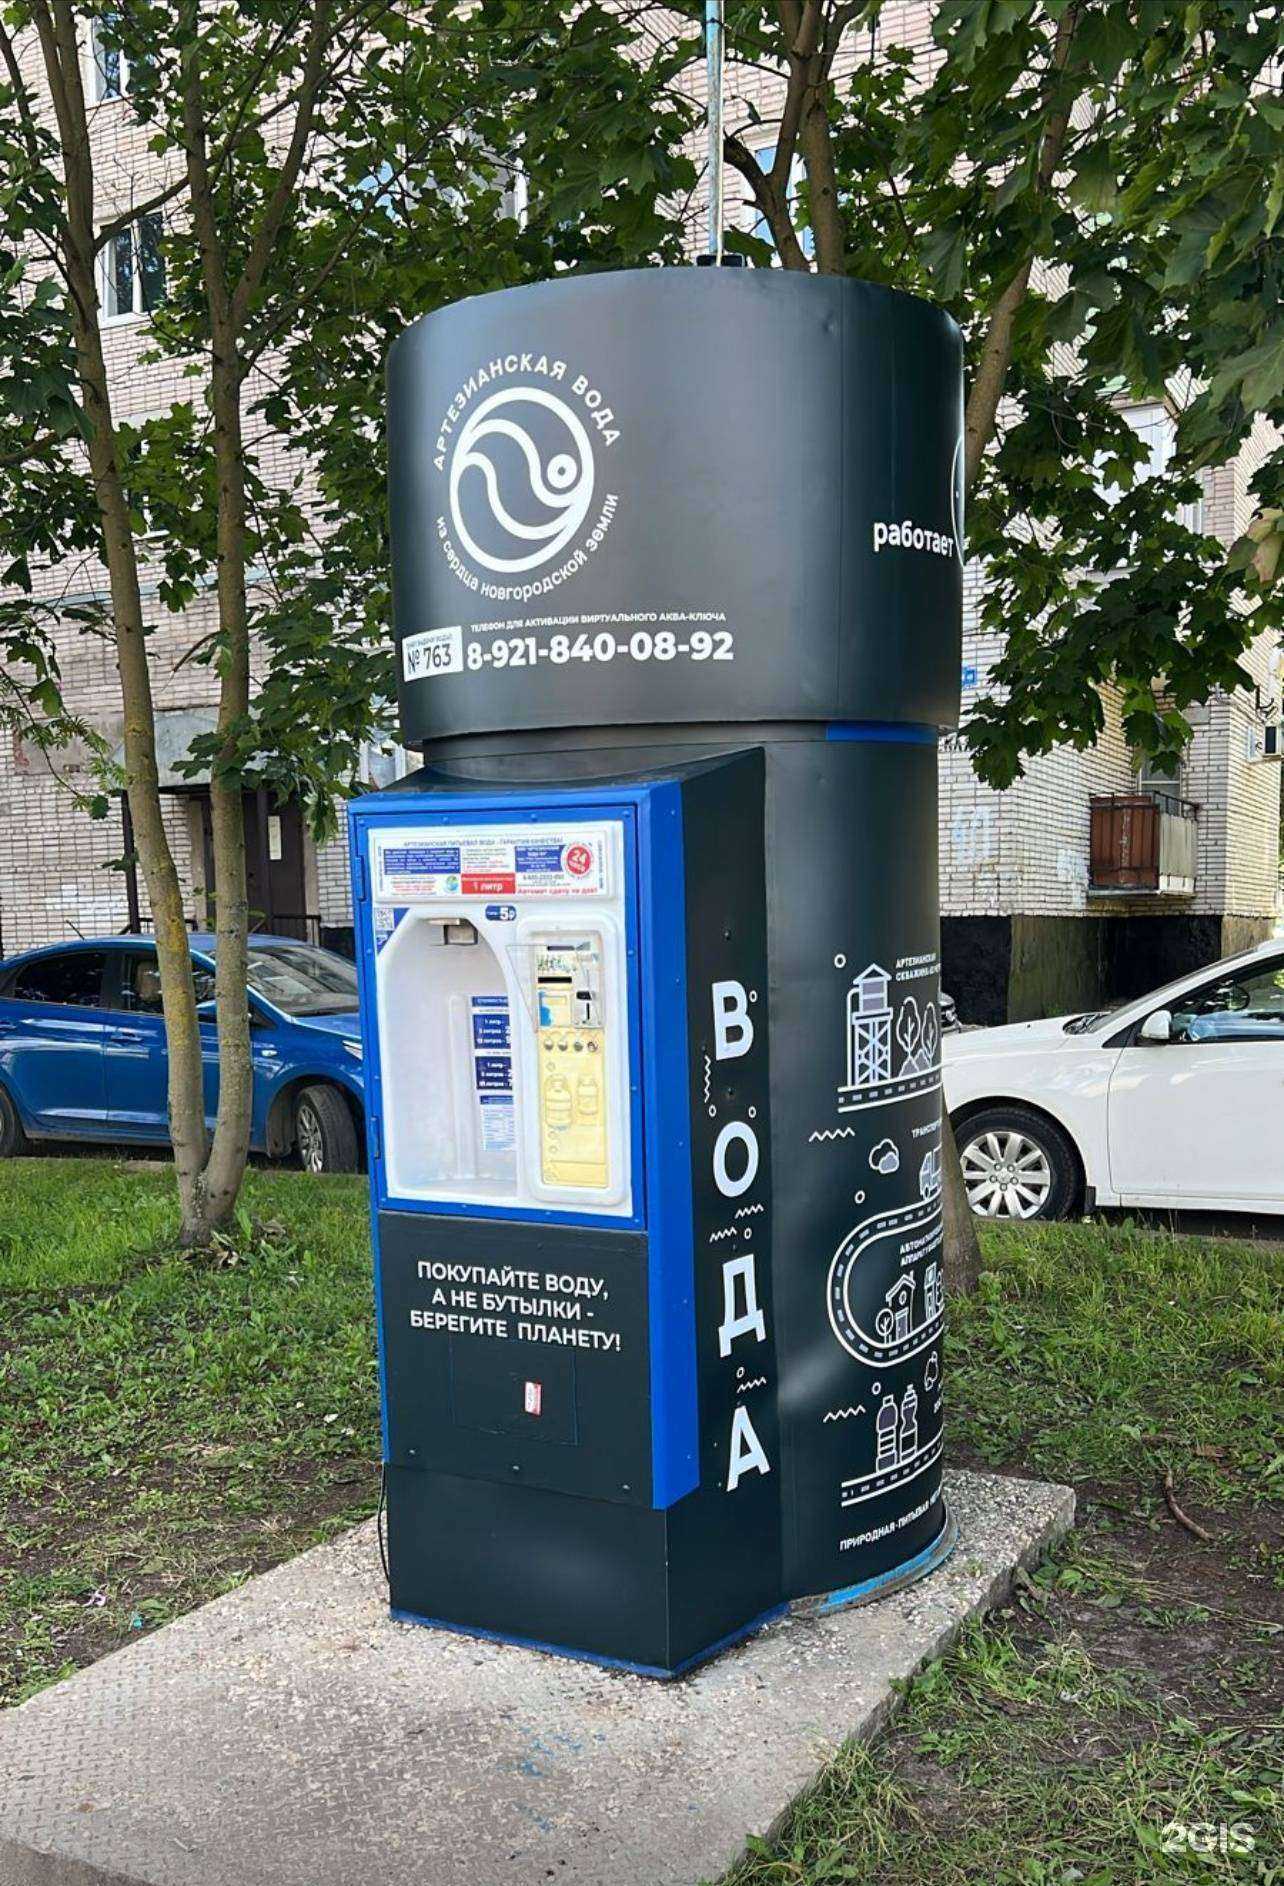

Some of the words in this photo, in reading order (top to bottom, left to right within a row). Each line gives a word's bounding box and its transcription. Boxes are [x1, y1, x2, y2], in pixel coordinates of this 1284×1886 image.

[433, 353, 568, 472] АРТЕЗИАНСКАЯ
[571, 374, 622, 448] ВОДА
[443, 540, 479, 591] сердца
[480, 547, 589, 602] новгородской
[586, 493, 620, 552] земли
[873, 520, 954, 558] работает
[471, 621, 506, 632] ТЕЛЕФОН
[506, 620, 523, 630] ДЛЯ
[524, 615, 579, 627] АКТИВАЦИИ
[580, 613, 657, 624] ВИРТУАЛЬНОГО
[659, 612, 727, 622] АКВА-КЛЮЧА
[423, 643, 452, 670] 763
[467, 631, 734, 670] 8-921-840-08-92
[417, 1260, 540, 1291] ПОКУПАЙТЕ
[545, 1274, 609, 1301] ВОДУ,
[431, 1288, 447, 1306] А
[451, 1290, 478, 1309] НЕ
[482, 1294, 582, 1321] БУТЫЛКИ
[410, 1310, 508, 1338] БЕРЕГИТЕ
[517, 1322, 622, 1352] ПЛАНЕТУ!
